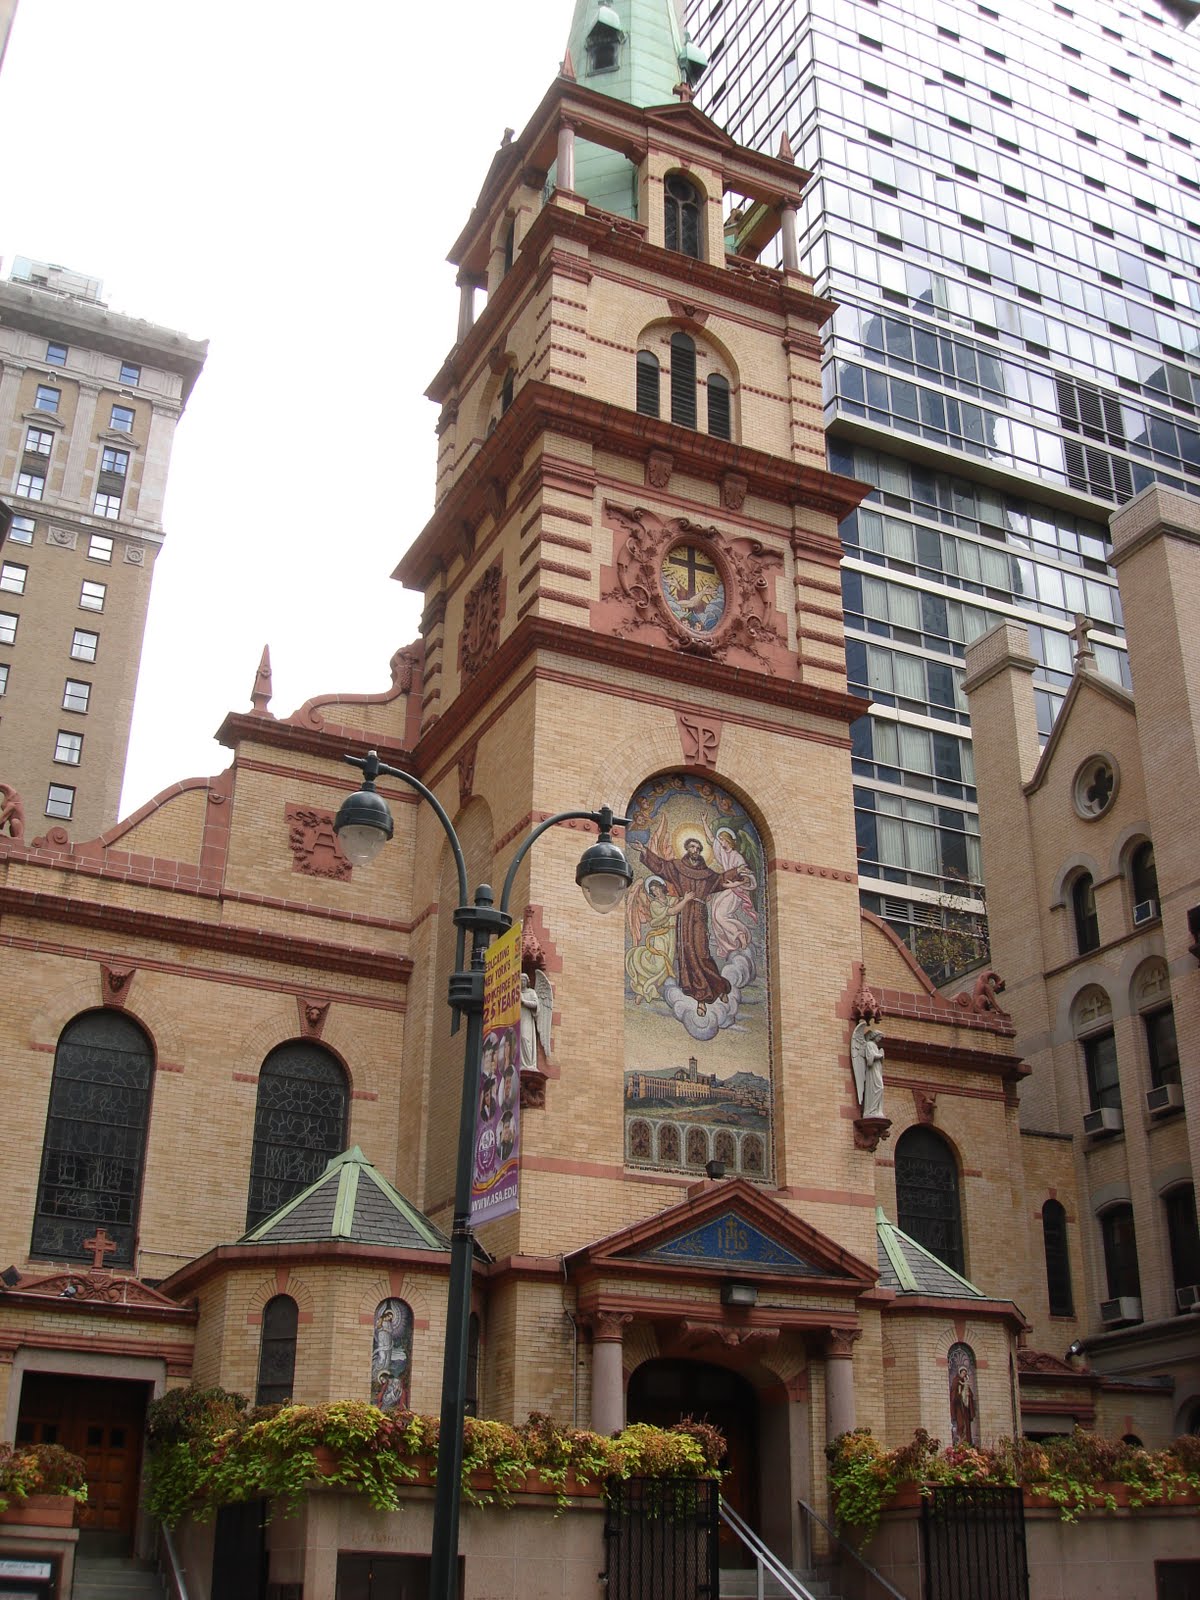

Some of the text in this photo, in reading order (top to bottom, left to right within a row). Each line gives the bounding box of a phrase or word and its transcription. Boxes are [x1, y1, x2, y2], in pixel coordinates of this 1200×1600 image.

[485, 946, 510, 972] EDUCATING
[483, 984, 520, 1025] 25 YEARS
[471, 1184, 517, 1211] WWW.ASA.EDU
